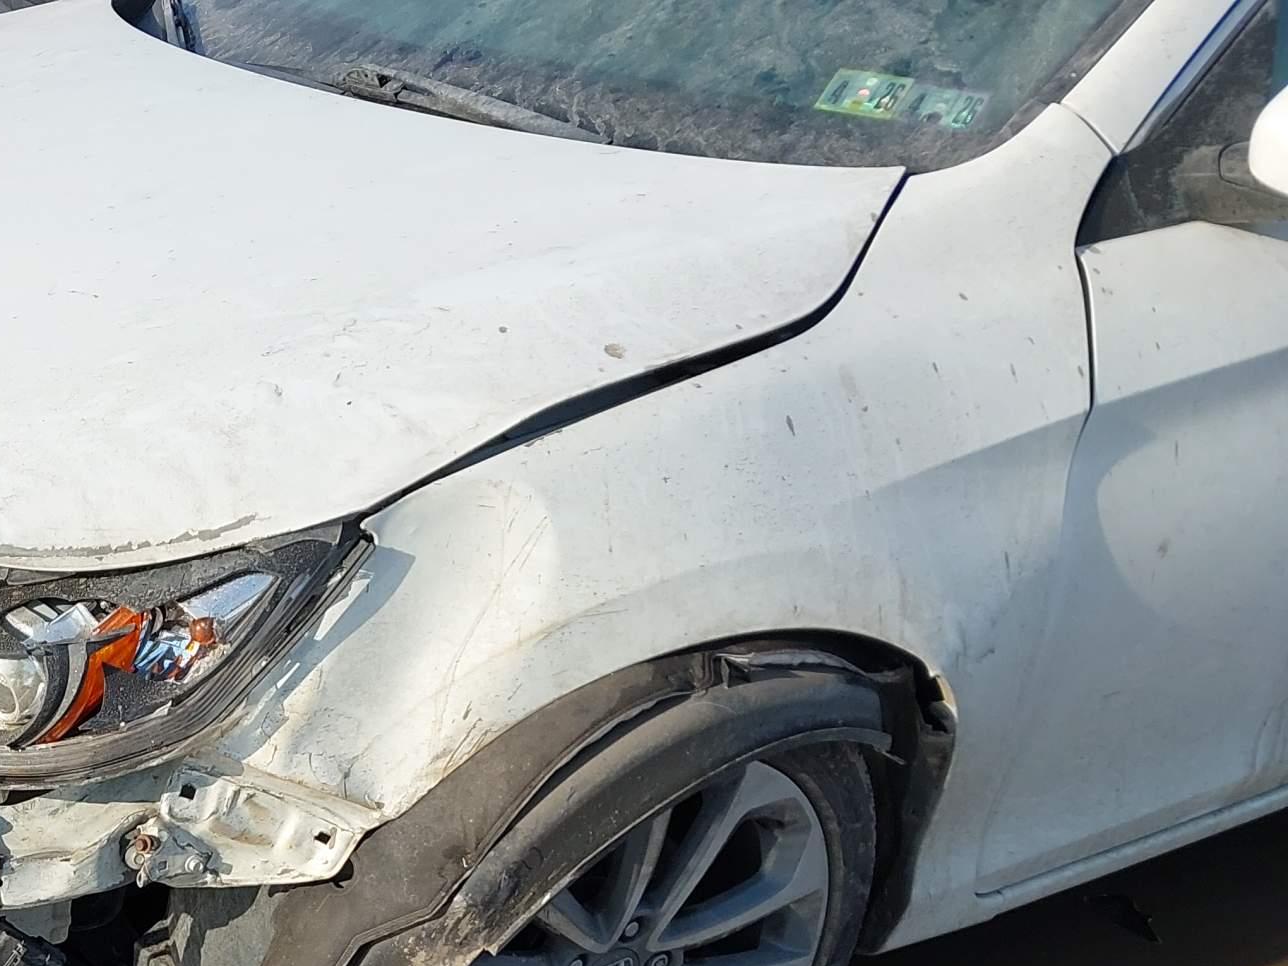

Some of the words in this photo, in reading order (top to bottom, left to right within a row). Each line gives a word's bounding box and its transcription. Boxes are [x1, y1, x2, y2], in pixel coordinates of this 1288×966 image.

[828, 79, 850, 104] 4
[873, 82, 906, 111] 26
[909, 93, 926, 112] 4
[953, 96, 984, 125] 26
